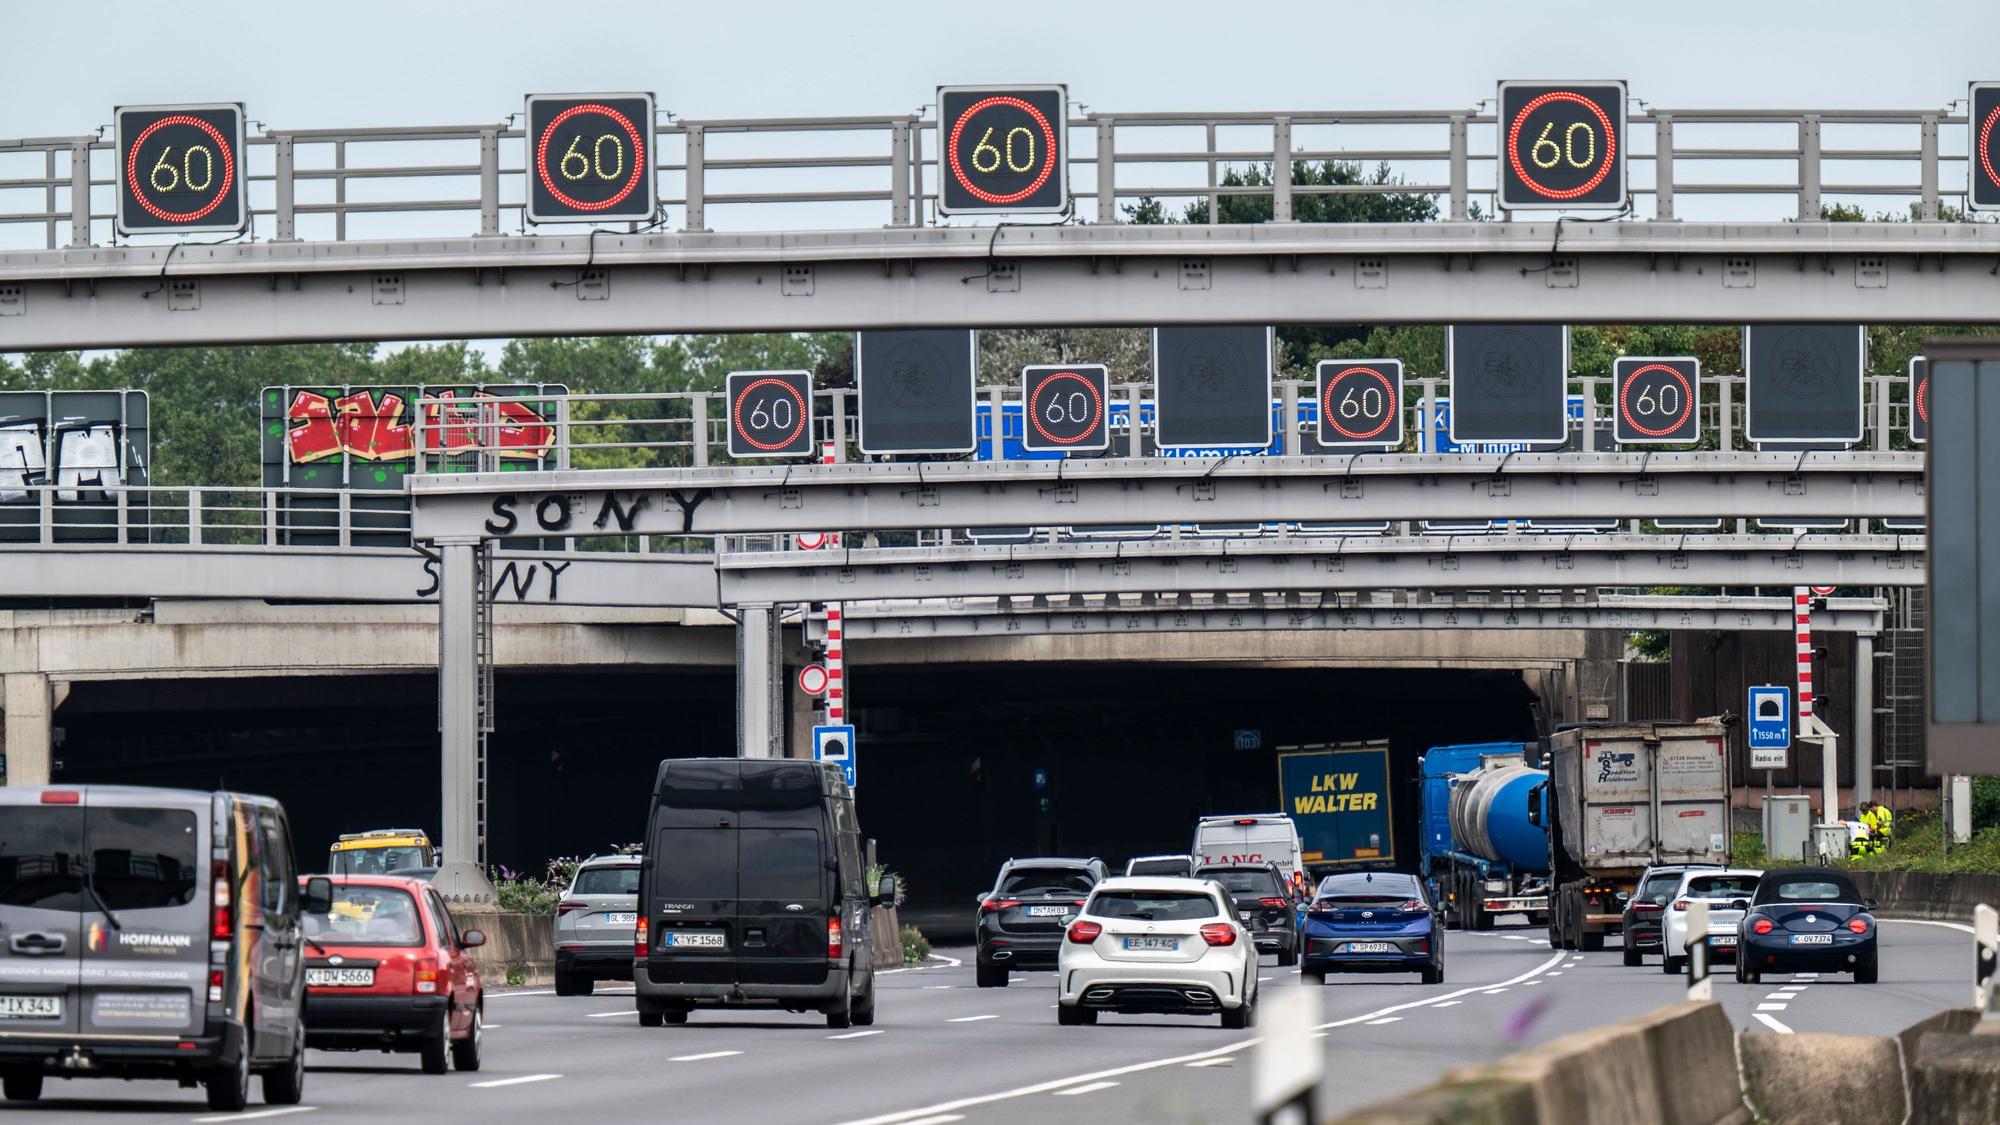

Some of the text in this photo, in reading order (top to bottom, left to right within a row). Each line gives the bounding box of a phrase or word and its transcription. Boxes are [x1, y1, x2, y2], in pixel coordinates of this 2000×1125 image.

[560, 133, 623, 180] 60
[971, 126, 1035, 173] 60
[1531, 121, 1595, 169] 60
[150, 144, 213, 193] 60
[750, 398, 792, 430] 60
[1045, 392, 1088, 424] 60
[1339, 387, 1382, 419] 60
[1636, 384, 1679, 416] 60
[485, 491, 714, 535] SONY
[417, 558, 570, 600] SNY
[1311, 772, 1358, 792] LKW
[1294, 792, 1378, 814] WALTER
[119, 933, 191, 947] HOFFMANN
